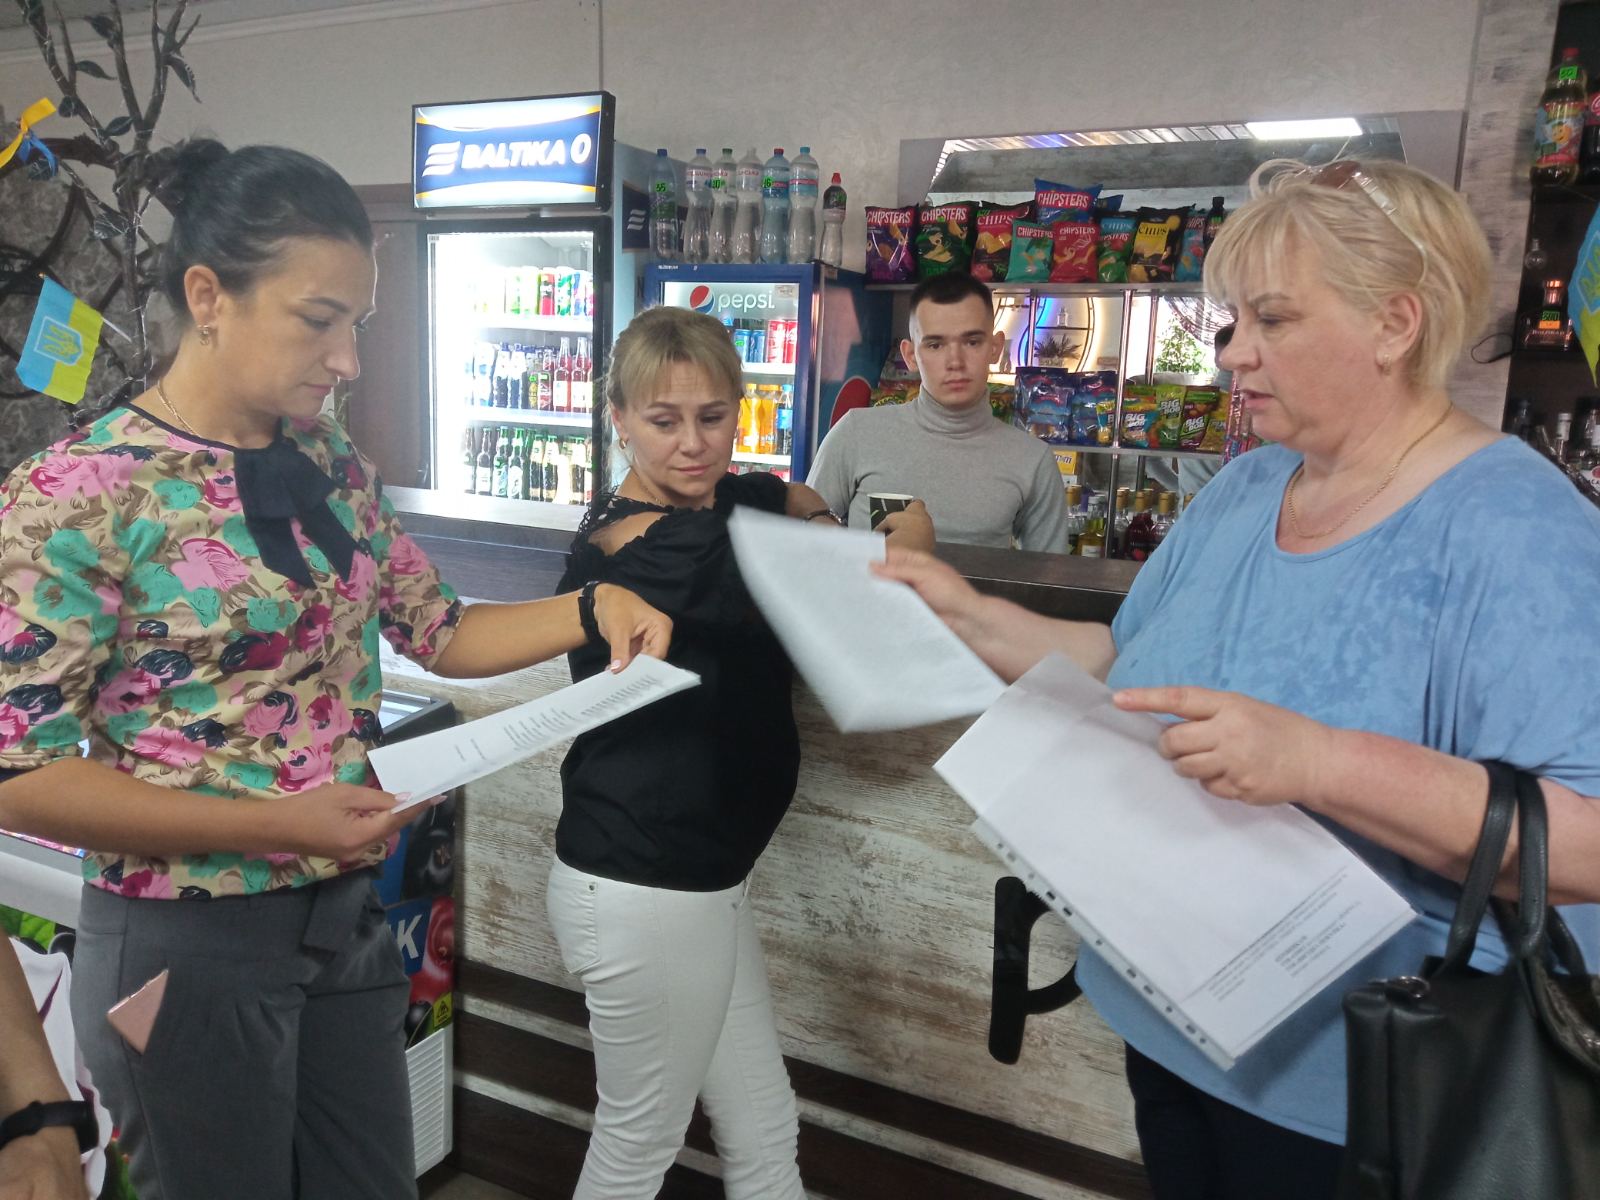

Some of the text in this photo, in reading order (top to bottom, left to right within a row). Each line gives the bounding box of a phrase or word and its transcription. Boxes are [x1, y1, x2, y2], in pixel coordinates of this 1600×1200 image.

[461, 133, 592, 169] BALTIKA 0
[1038, 192, 1089, 210] CHIPSTERS
[866, 211, 911, 225] CHIPSTERS
[921, 207, 967, 222] CHIPSTERS
[977, 214, 1014, 226] CHIPS
[1059, 226, 1096, 236] CHIPSTERS
[1139, 224, 1167, 237] CHIPS
[718, 290, 774, 313] pepsi
[1161, 400, 1180, 412] BIG
[1125, 413, 1147, 421] BIG
[1185, 416, 1204, 427] BIG
